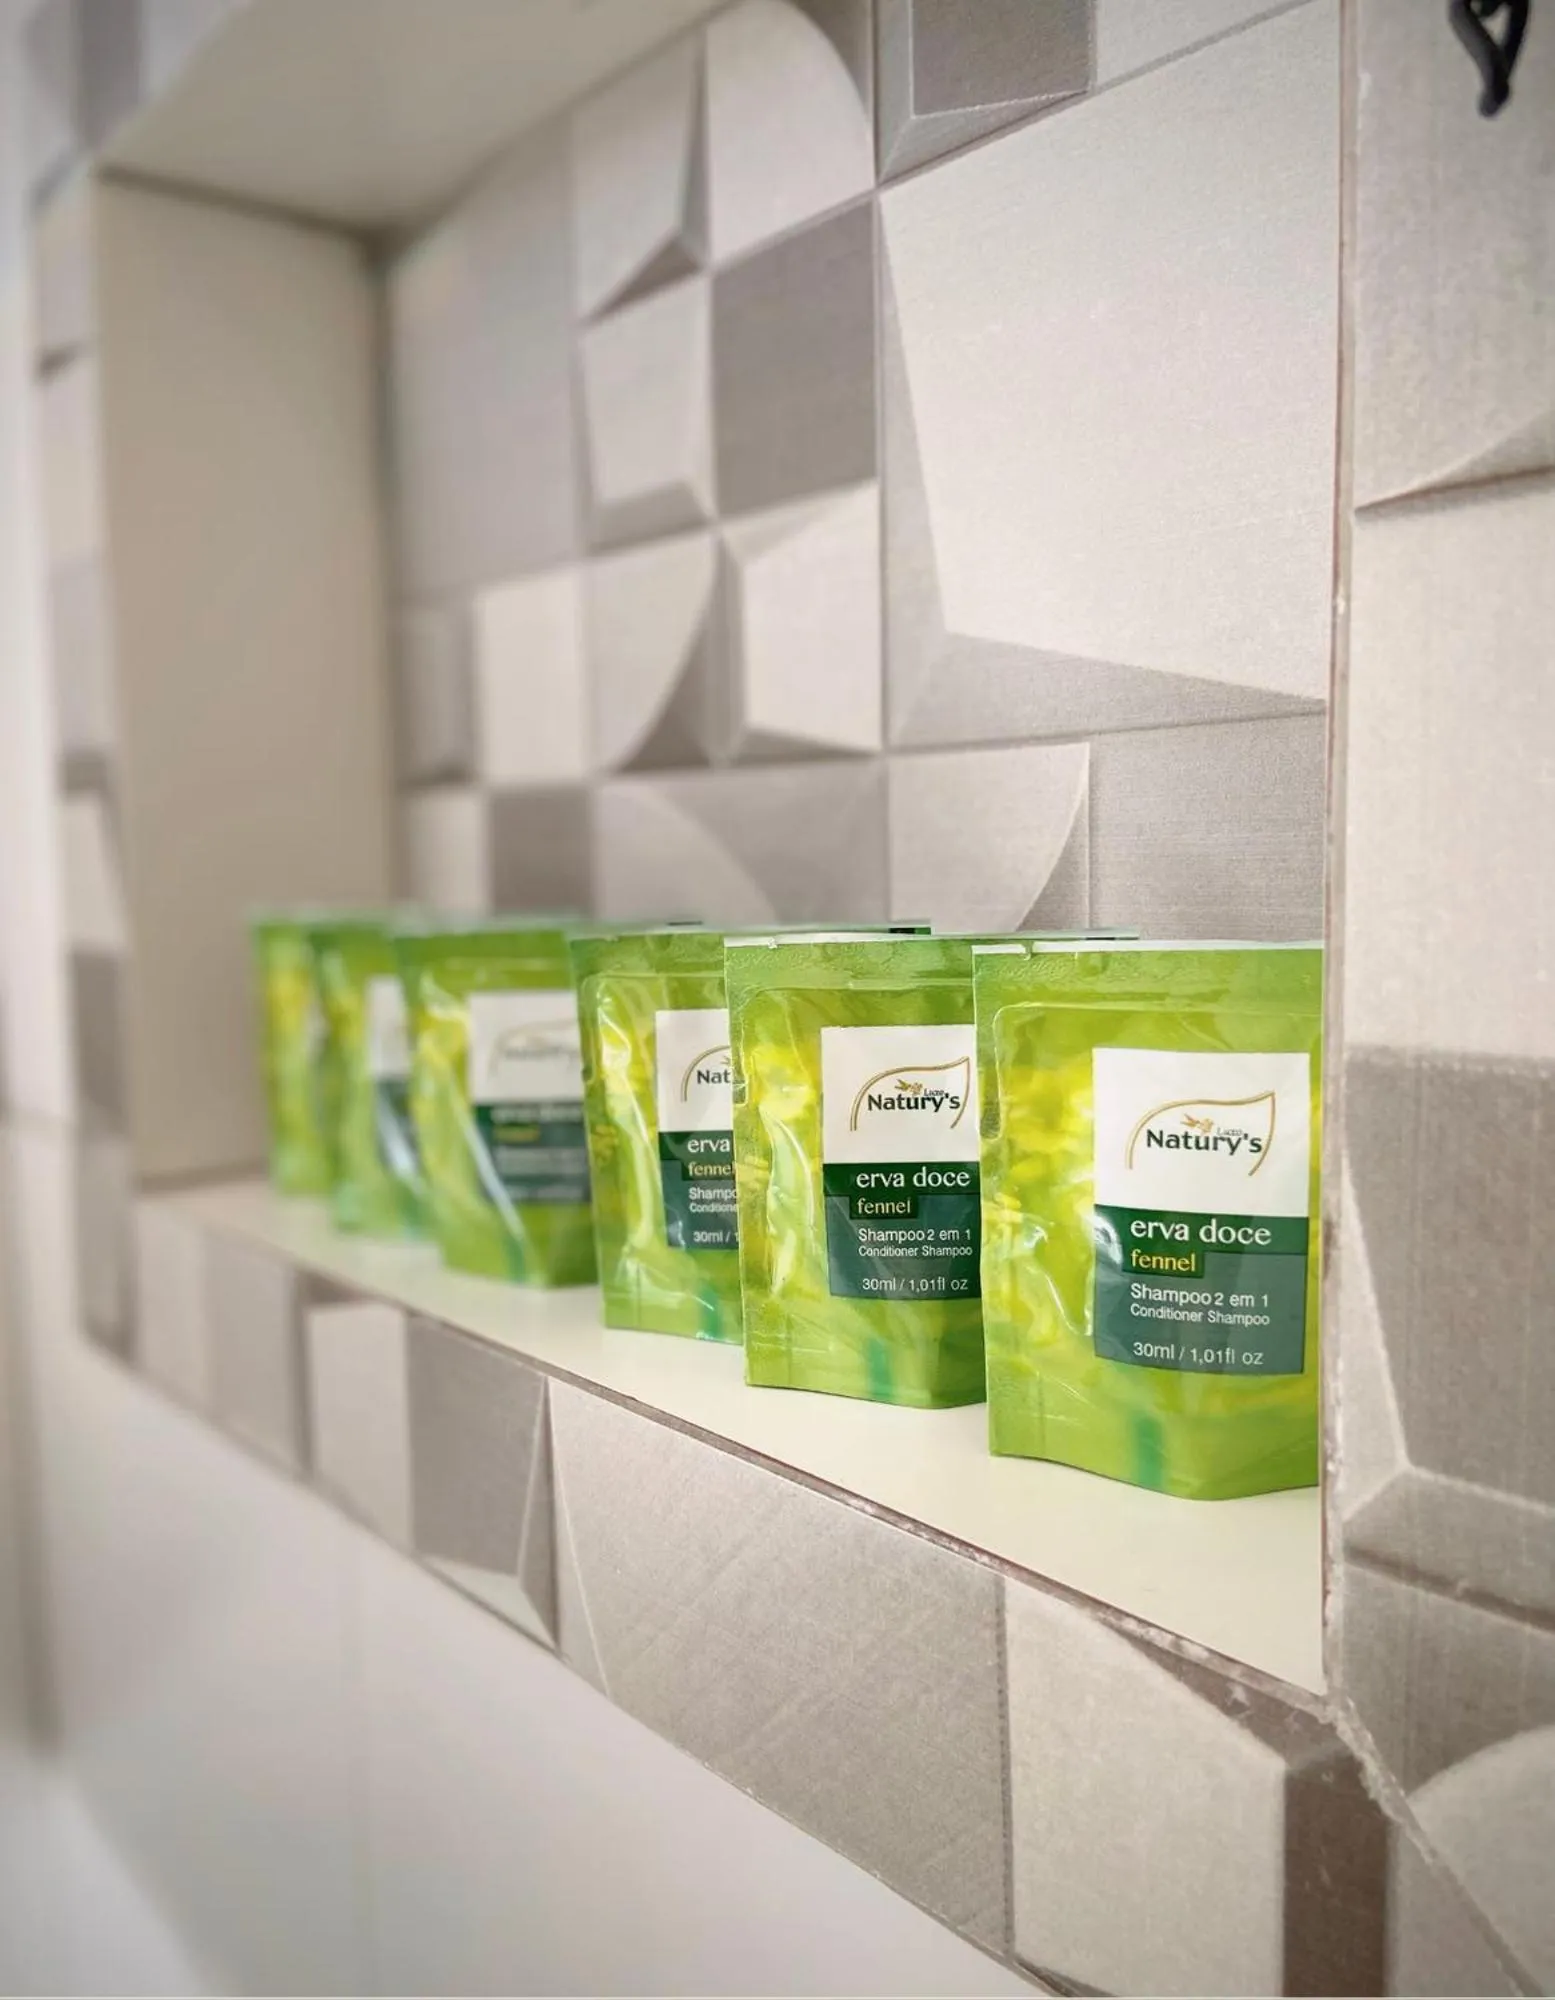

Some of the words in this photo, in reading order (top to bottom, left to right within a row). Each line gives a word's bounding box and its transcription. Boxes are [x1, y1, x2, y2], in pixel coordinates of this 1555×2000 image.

[867, 1092, 961, 1113] Natury's
[687, 1138, 731, 1153] erva
[1146, 1128, 1263, 1156] Natury's
[856, 1172, 905, 1188] erva
[912, 1166, 971, 1188] doce
[857, 1197, 911, 1214] fennel
[693, 1231, 723, 1243] 30ml
[858, 1228, 924, 1244] Shampoo
[926, 1229, 935, 1241] 2
[939, 1230, 960, 1241] em
[965, 1229, 971, 1241] 1
[1130, 1219, 1190, 1241] erva
[1199, 1218, 1272, 1245] doce
[858, 1245, 919, 1257] Conditioner
[922, 1245, 973, 1258] Shampoo
[1131, 1249, 1196, 1272] fennel
[862, 1277, 896, 1291] 30ml
[950, 1279, 969, 1291] oz
[1130, 1282, 1212, 1306] Shampoo
[1214, 1292, 1225, 1306] 2
[1229, 1295, 1255, 1307] em
[1261, 1294, 1269, 1308] 1
[1130, 1303, 1204, 1323] Conditioner
[1207, 1310, 1270, 1327] Shampoo
[1133, 1341, 1175, 1360] 30ml
[1242, 1353, 1264, 1365] oz
